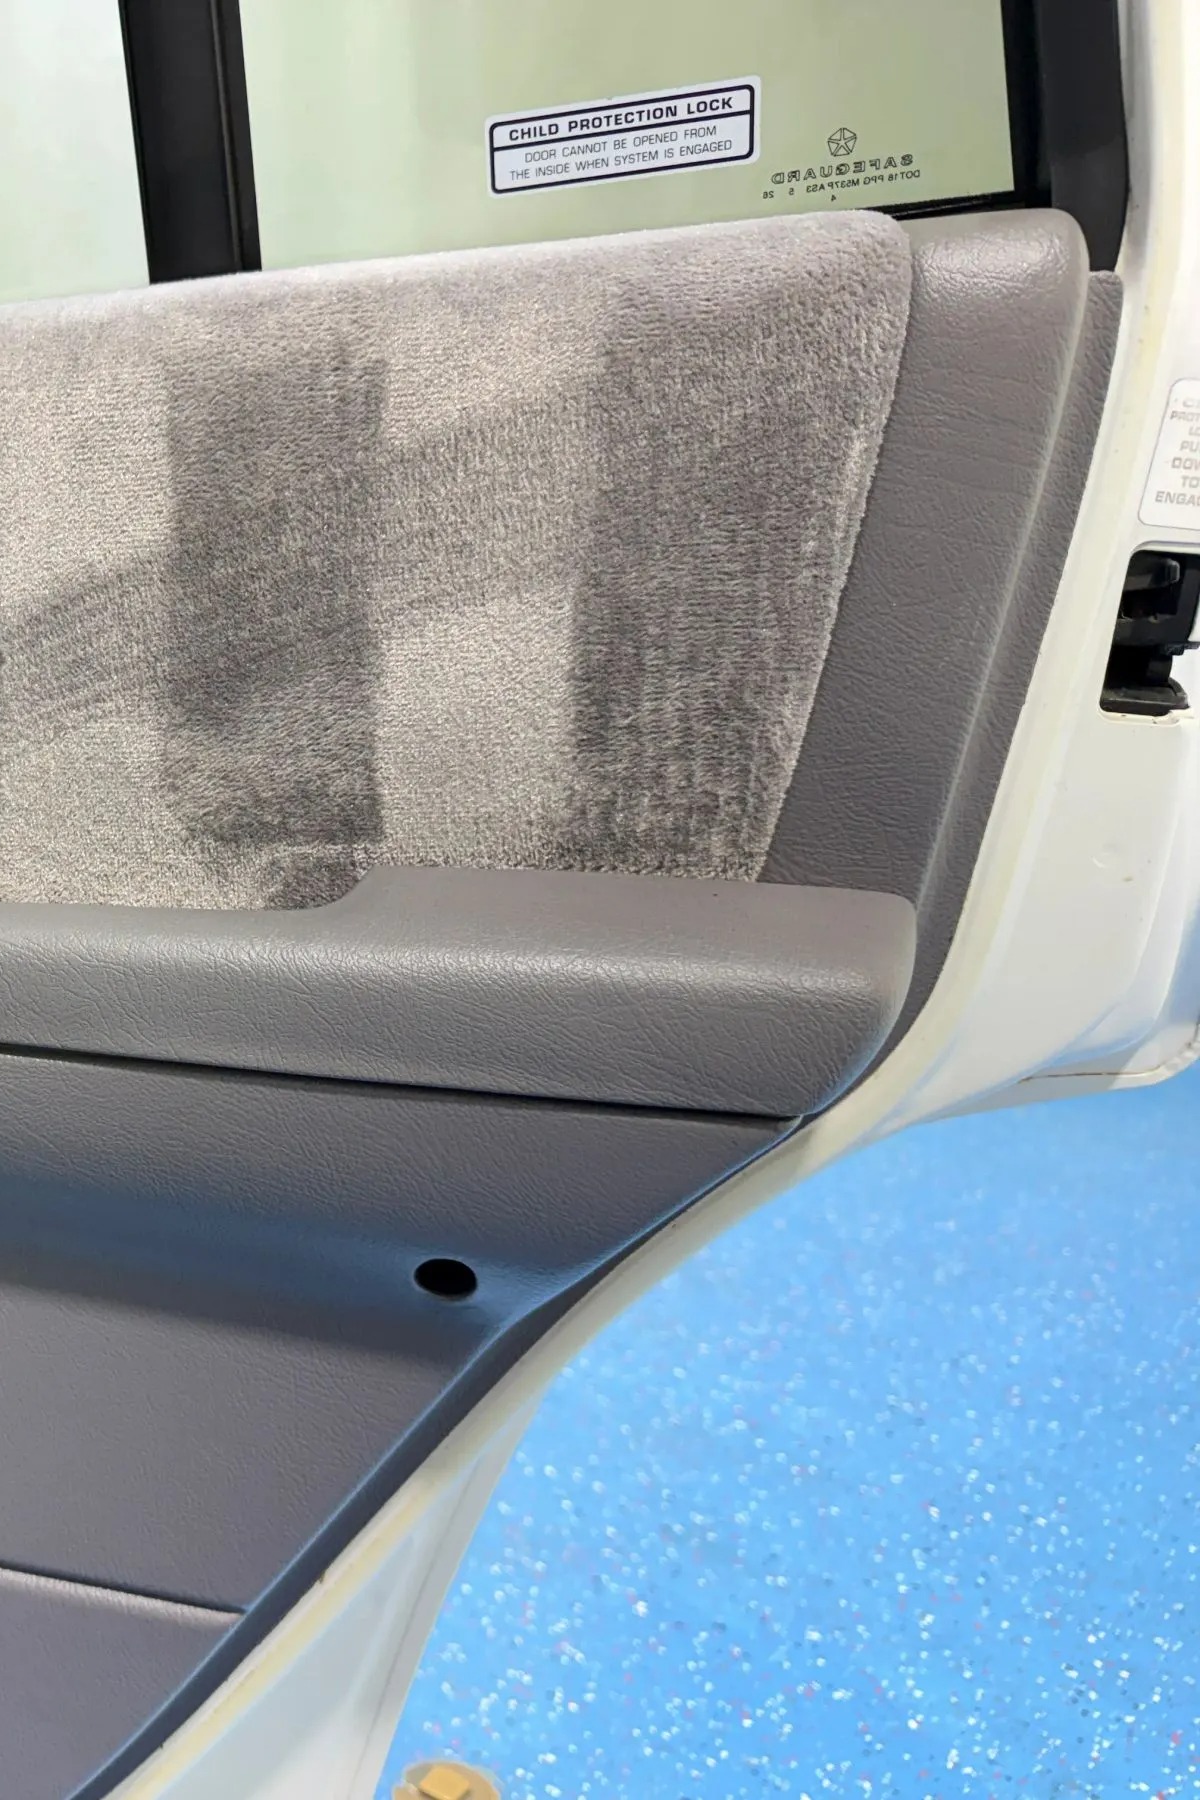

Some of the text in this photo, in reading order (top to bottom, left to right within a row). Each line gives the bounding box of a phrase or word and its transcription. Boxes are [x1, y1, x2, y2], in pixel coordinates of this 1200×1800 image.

[509, 96, 734, 141] CHILD PROTECTION LOCK
[510, 139, 733, 181] THE INSIDE WHEN SYSTEM IS ENGAGED
[525, 125, 717, 164] DOOR CANNOT BE OPENED FROM
